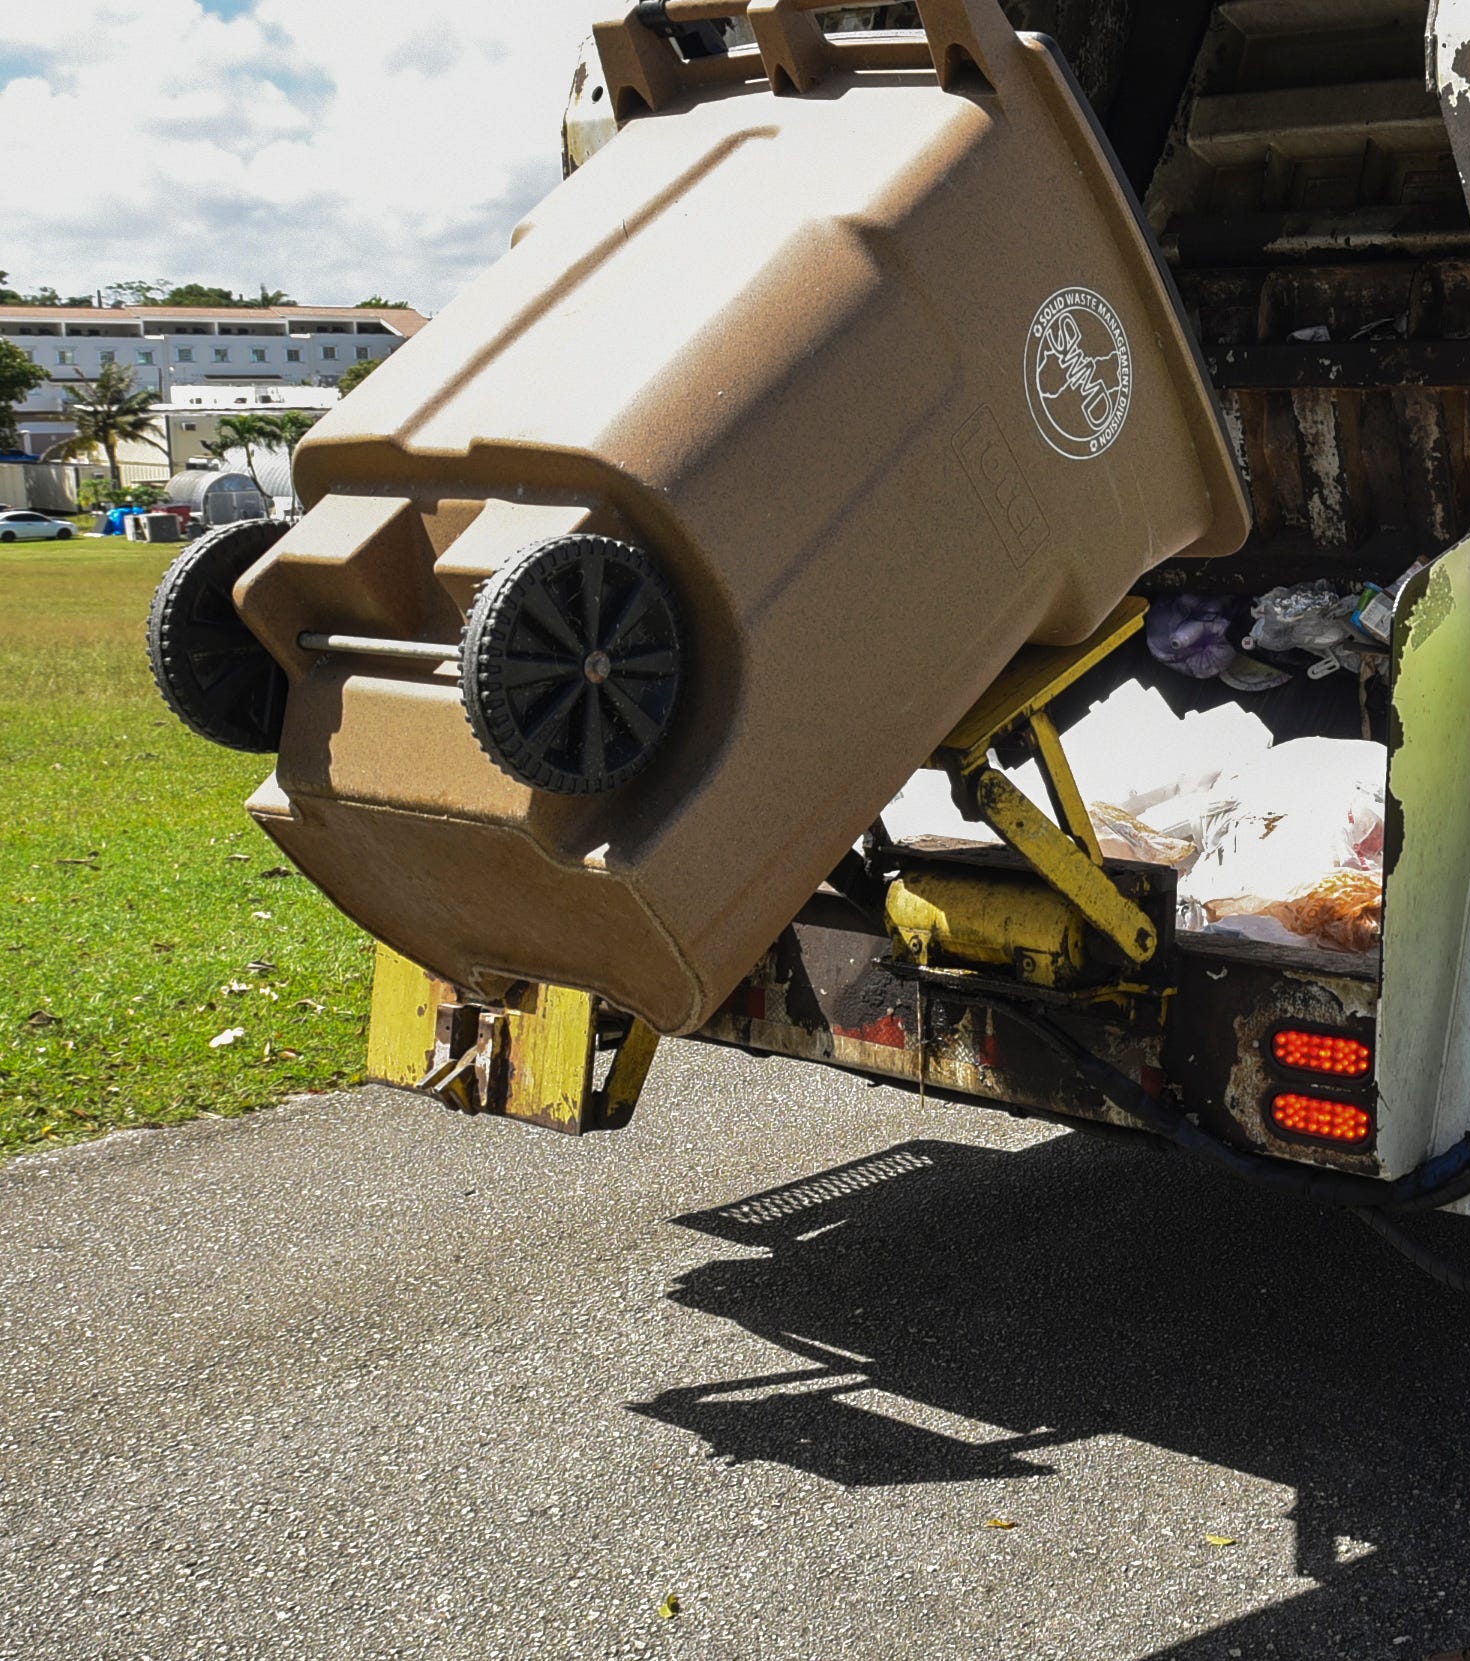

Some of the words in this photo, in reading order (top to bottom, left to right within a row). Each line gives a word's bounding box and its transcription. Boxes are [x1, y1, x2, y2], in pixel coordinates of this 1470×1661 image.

[1039, 297, 1065, 327] SOLID
[1065, 292, 1097, 309] WASTE
[1046, 312, 1113, 431] SWMD
[1098, 304, 1129, 396] MANAGEMENT
[1099, 396, 1127, 447] DIVISION
